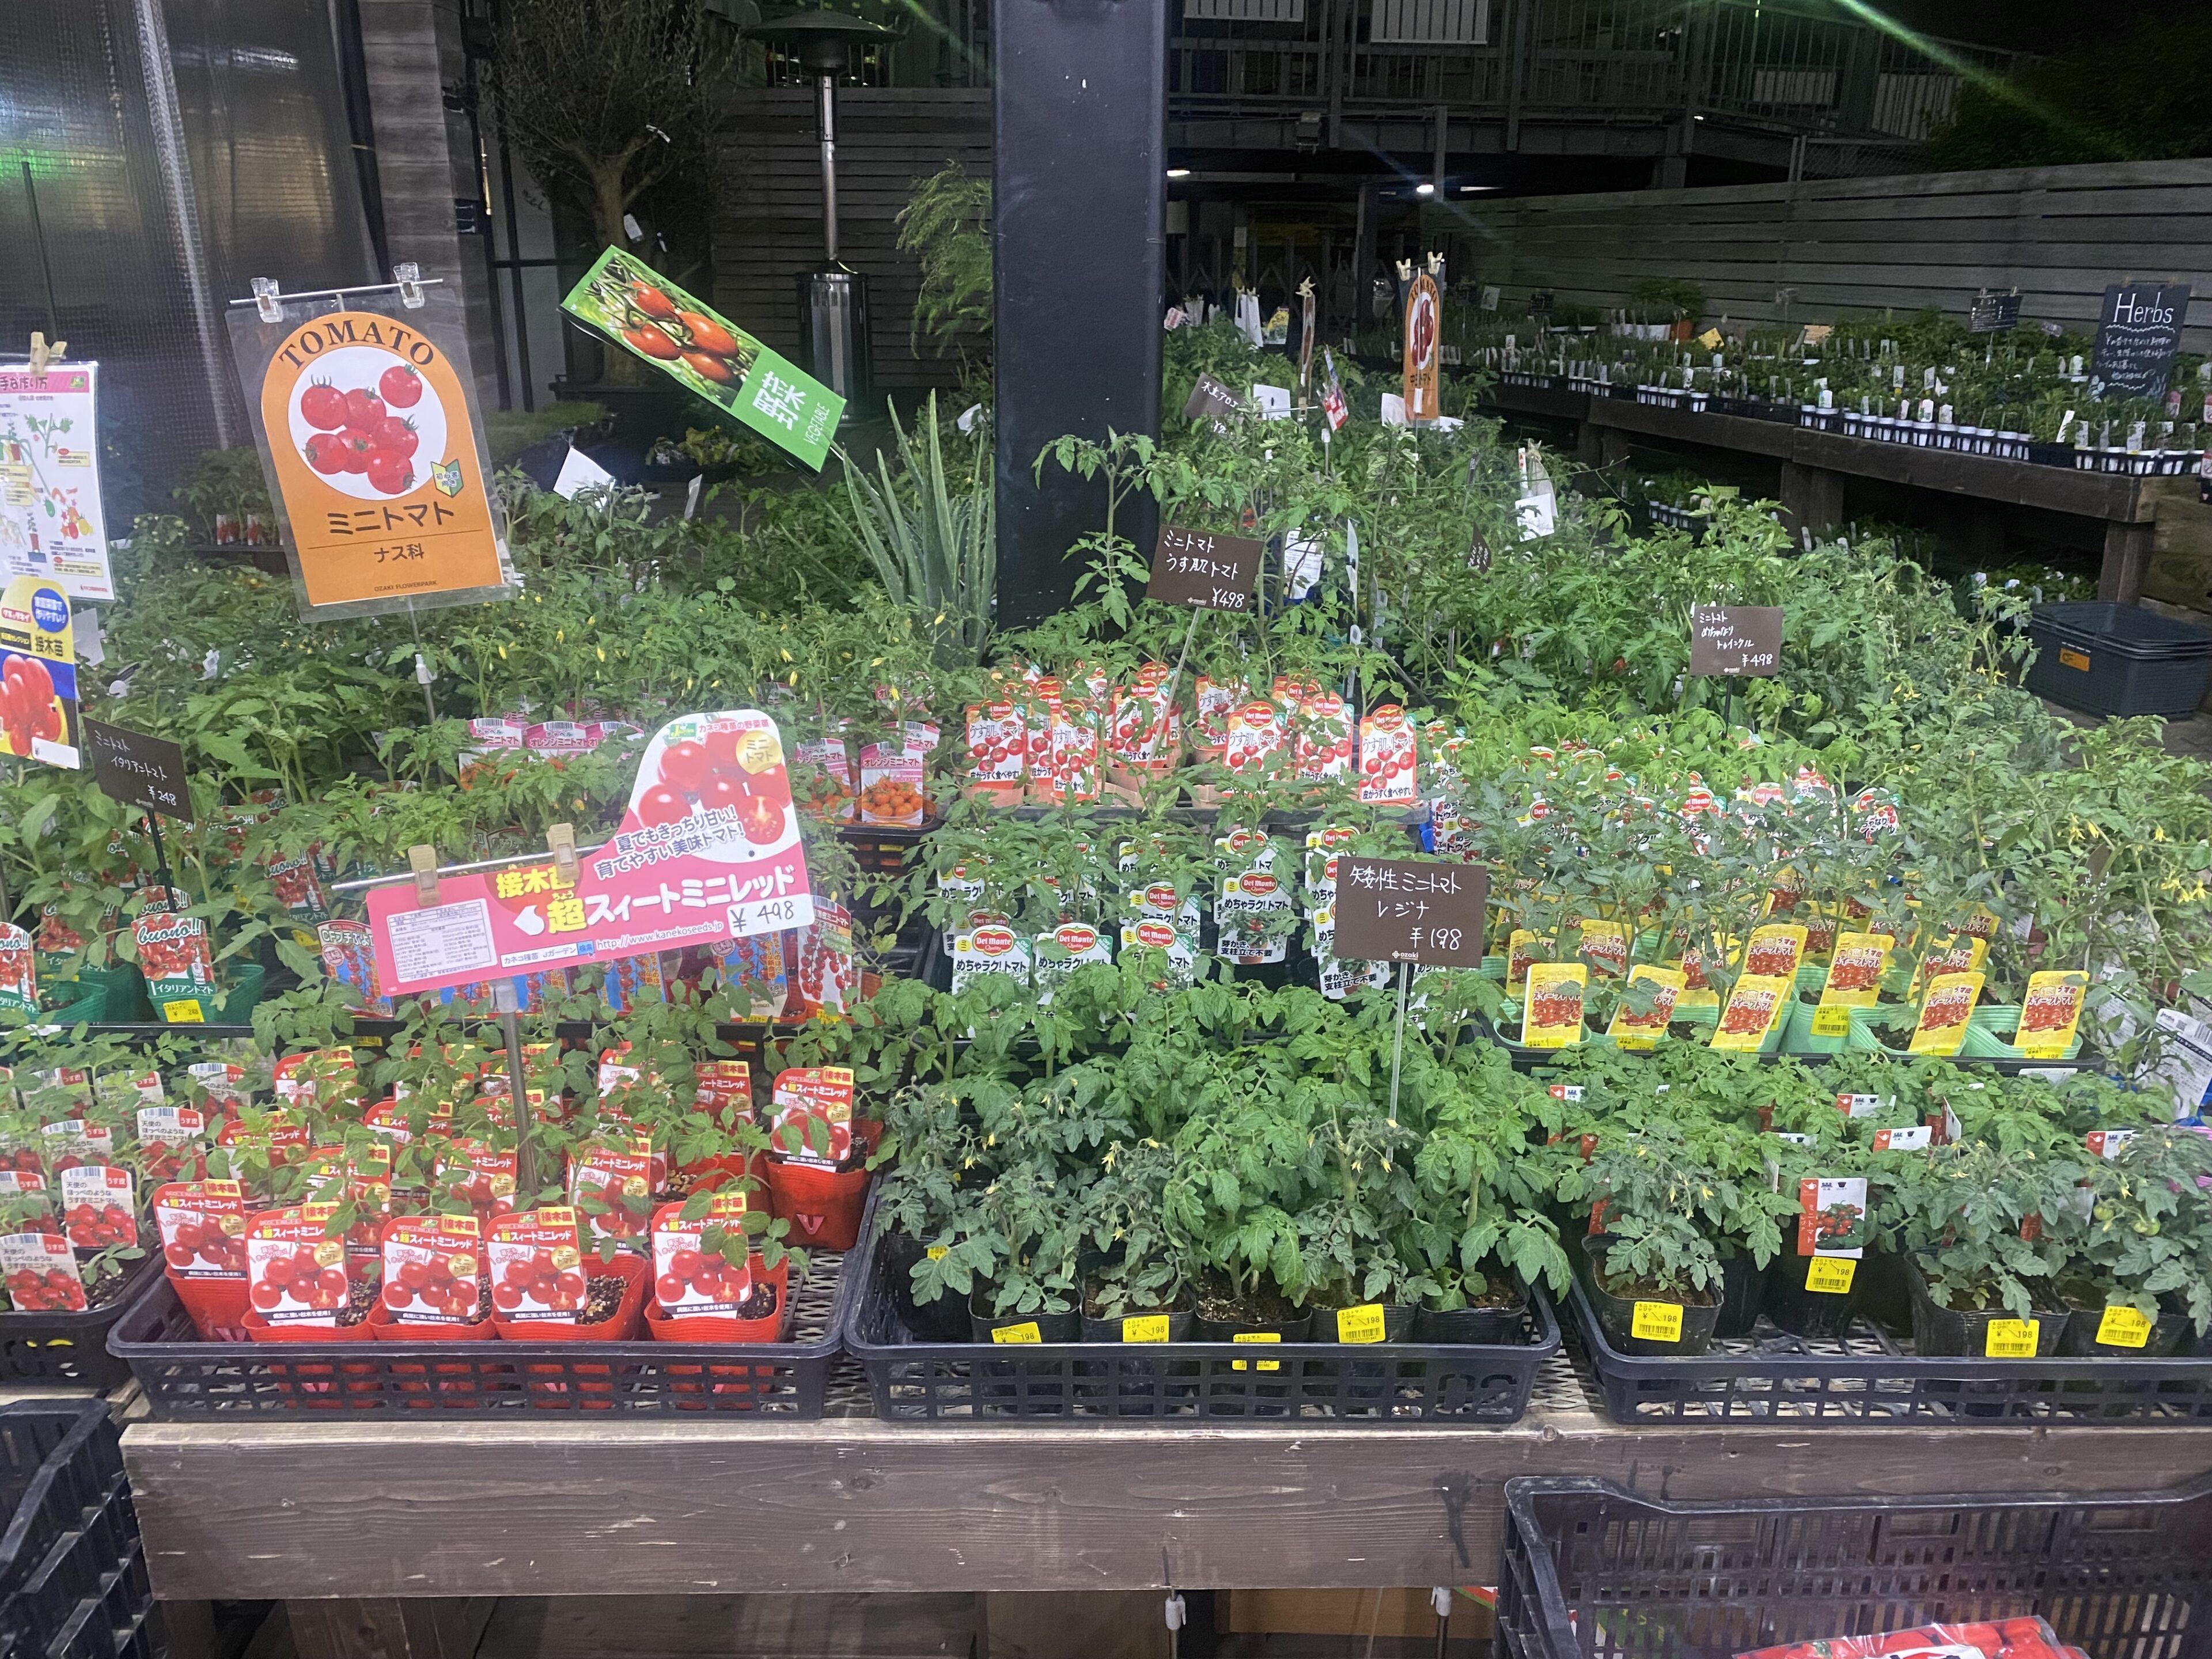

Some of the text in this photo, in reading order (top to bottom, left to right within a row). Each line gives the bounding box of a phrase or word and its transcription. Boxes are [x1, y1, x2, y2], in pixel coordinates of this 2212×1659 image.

[2113, 291, 2174, 323] Herbs
[279, 320, 434, 370] TOMATO
[752, 370, 806, 430] 野菜
[802, 402, 830, 446] VEGETABLE
[436, 472, 459, 480] 初心者
[327, 501, 454, 535] ミニトマト
[1164, 530, 1215, 553] ミニトマト
[374, 543, 425, 563] ナス科
[1166, 553, 1238, 580] うす肌トマト
[396, 581, 437, 589] FLOWERPARK
[1212, 587, 1244, 608] ¥498
[1699, 611, 1728, 623] ミニトマト
[36, 636, 63, 656] 接木苗
[1742, 653, 1773, 667] ¥498
[699, 720, 769, 733] カネコ種苗の野菜苗
[94, 730, 130, 752] ミニトマト
[529, 737, 588, 748] オレンジミニトマト
[747, 739, 770, 749] ミニ
[747, 752, 773, 764] トマト
[864, 758, 920, 767] オレンジミニトマト
[1362, 787, 1414, 800] 皮がうすく食べやすい
[617, 806, 738, 854] 夏でもきっちり甘い!
[596, 823, 747, 880] 育てやすい美味トマト!
[1402, 871, 1462, 895] ミニトマト
[547, 865, 796, 935] 超スィートミニレッド
[552, 891, 574, 901] ちょう
[1224, 899, 1289, 911] めちゃラク!トマト
[1377, 900, 1430, 921] レジナ
[730, 900, 794, 933] ¥ 498
[138, 917, 202, 945] buono!!
[597, 922, 724, 950] http://www.kanekoseeds.jp
[1139, 929, 1172, 940] Del Monte
[988, 938, 1011, 946] Monte
[1071, 935, 1093, 943] Monte
[1430, 927, 1463, 950] 198
[1778, 938, 1797, 946] うす皮
[504, 946, 577, 965] カネコ種苗 Jガーデン
[1749, 946, 1795, 956] スイーツトマト
[1865, 949, 1883, 958] うす皮
[956, 959, 1027, 973] めちゃラク!トマト
[1833, 956, 1880, 968] スイーツトマト
[156, 984, 214, 995] イタリアントマト
[1953, 986, 1974, 995] うす皮
[2057, 986, 2077, 994] うす皮
[1760, 991, 1775, 1001] うす皮
[1927, 996, 1969, 1007] スイーツトマト
[2027, 996, 2075, 1005] スイーツトマト
[1729, 998, 1773, 1011] スイーツトマト
[823, 1070, 852, 1082] 接木苗
[787, 1082, 849, 1098] 超スィートミニレッド
[180, 1116, 199, 1124] うす皮
[207, 1181, 237, 1194] 接木苗
[169, 1198, 238, 1210] 超スィートミニレッド
[540, 1211, 573, 1222] 接木苗
[444, 1219, 476, 1231] 接木苗
[399, 1232, 474, 1249] 超スィートミニレッド
[501, 1230, 572, 1243] 超スィートミニレッド
[320, 1245, 336, 1253] ミニ
[319, 1253, 338, 1261] トマト
[556, 1257, 575, 1265] トマト
[1663, 1315, 1677, 1323] 198
[2131, 1320, 2147, 1328] 198
[1152, 1326, 1165, 1334] 198
[1021, 1333, 1035, 1341] 198
